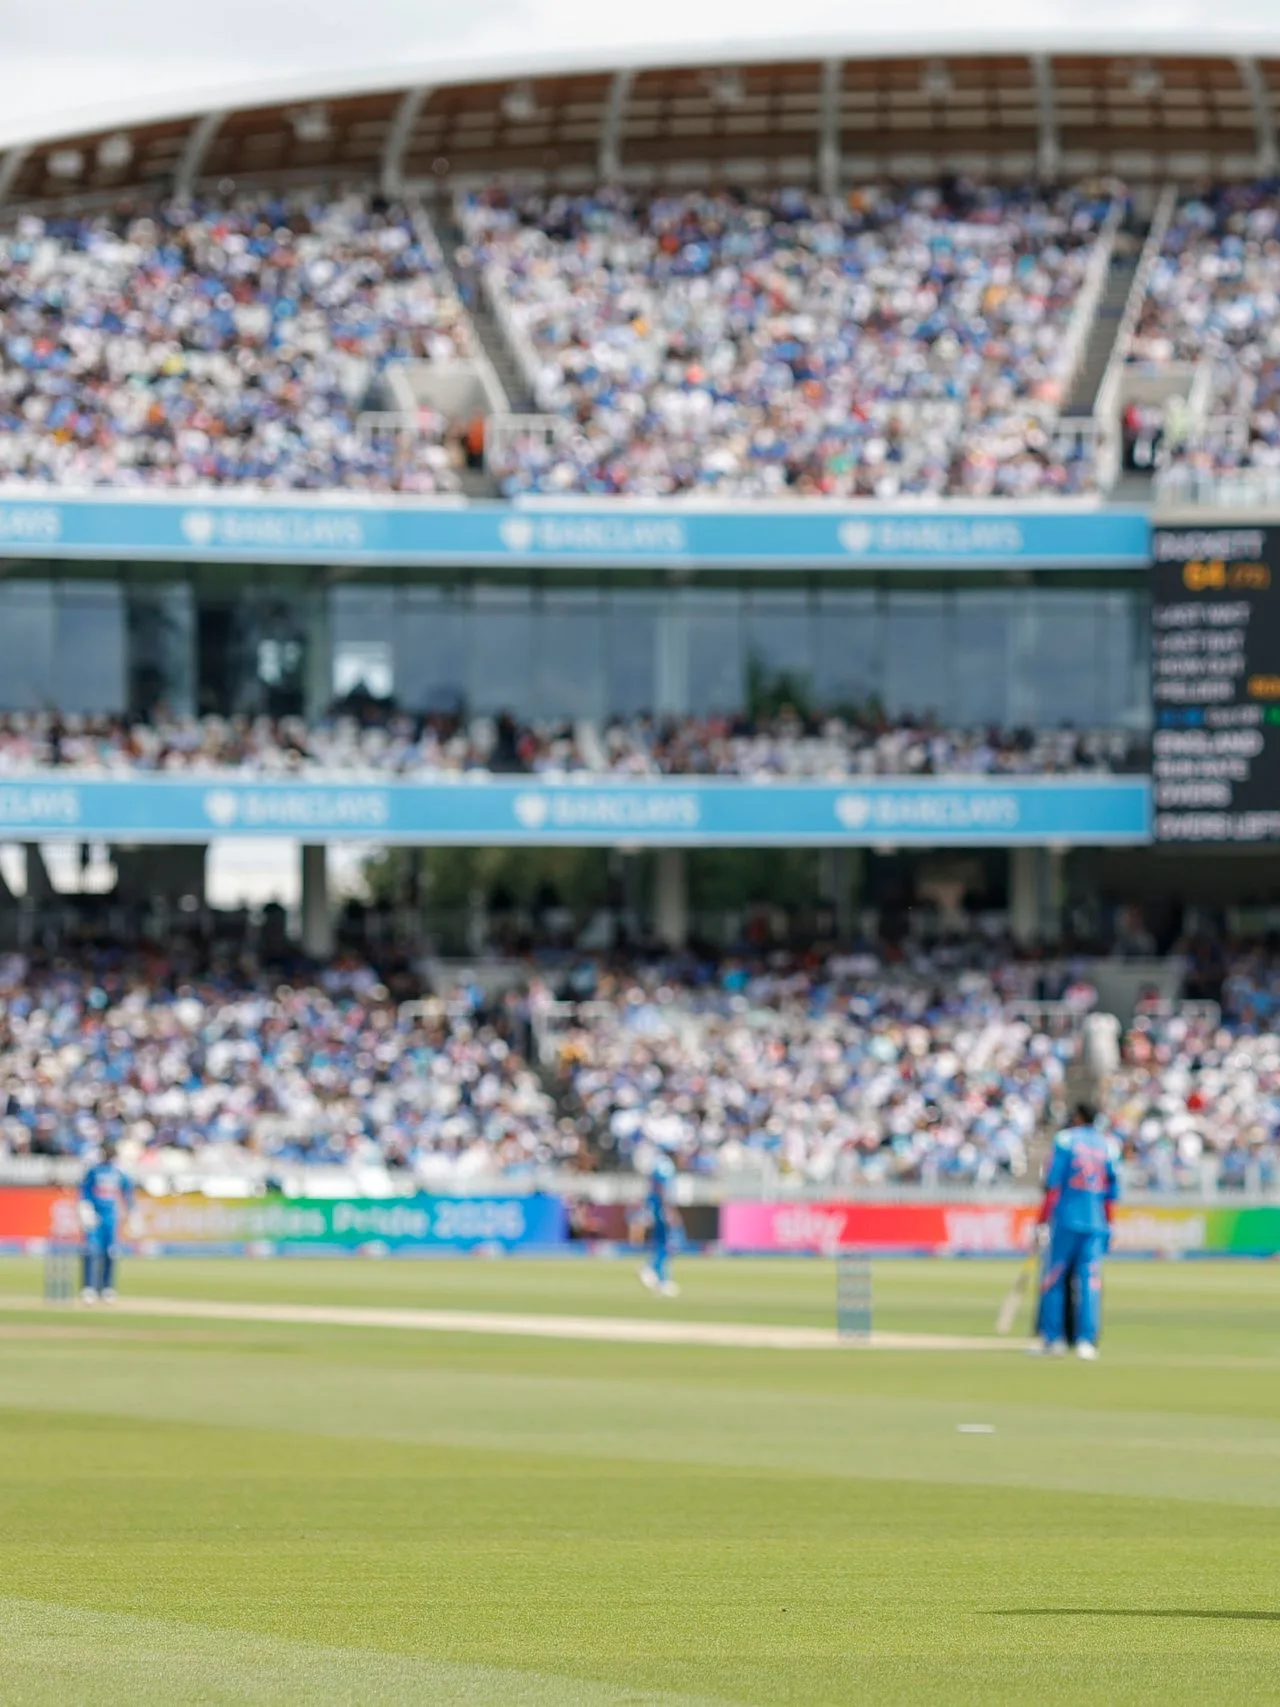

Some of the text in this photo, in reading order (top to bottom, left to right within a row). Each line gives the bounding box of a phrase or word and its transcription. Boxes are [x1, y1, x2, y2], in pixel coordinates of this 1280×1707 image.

[224, 513, 361, 546] BARCLAYS
[545, 519, 682, 552] BARCLAYS
[879, 523, 1023, 556] BARCLAYS
[1184, 556, 1225, 588] 64
[245, 791, 386, 824] BARCLAYS
[553, 793, 697, 827] BARCLAYS
[876, 794, 1018, 828] BARCLAYS
